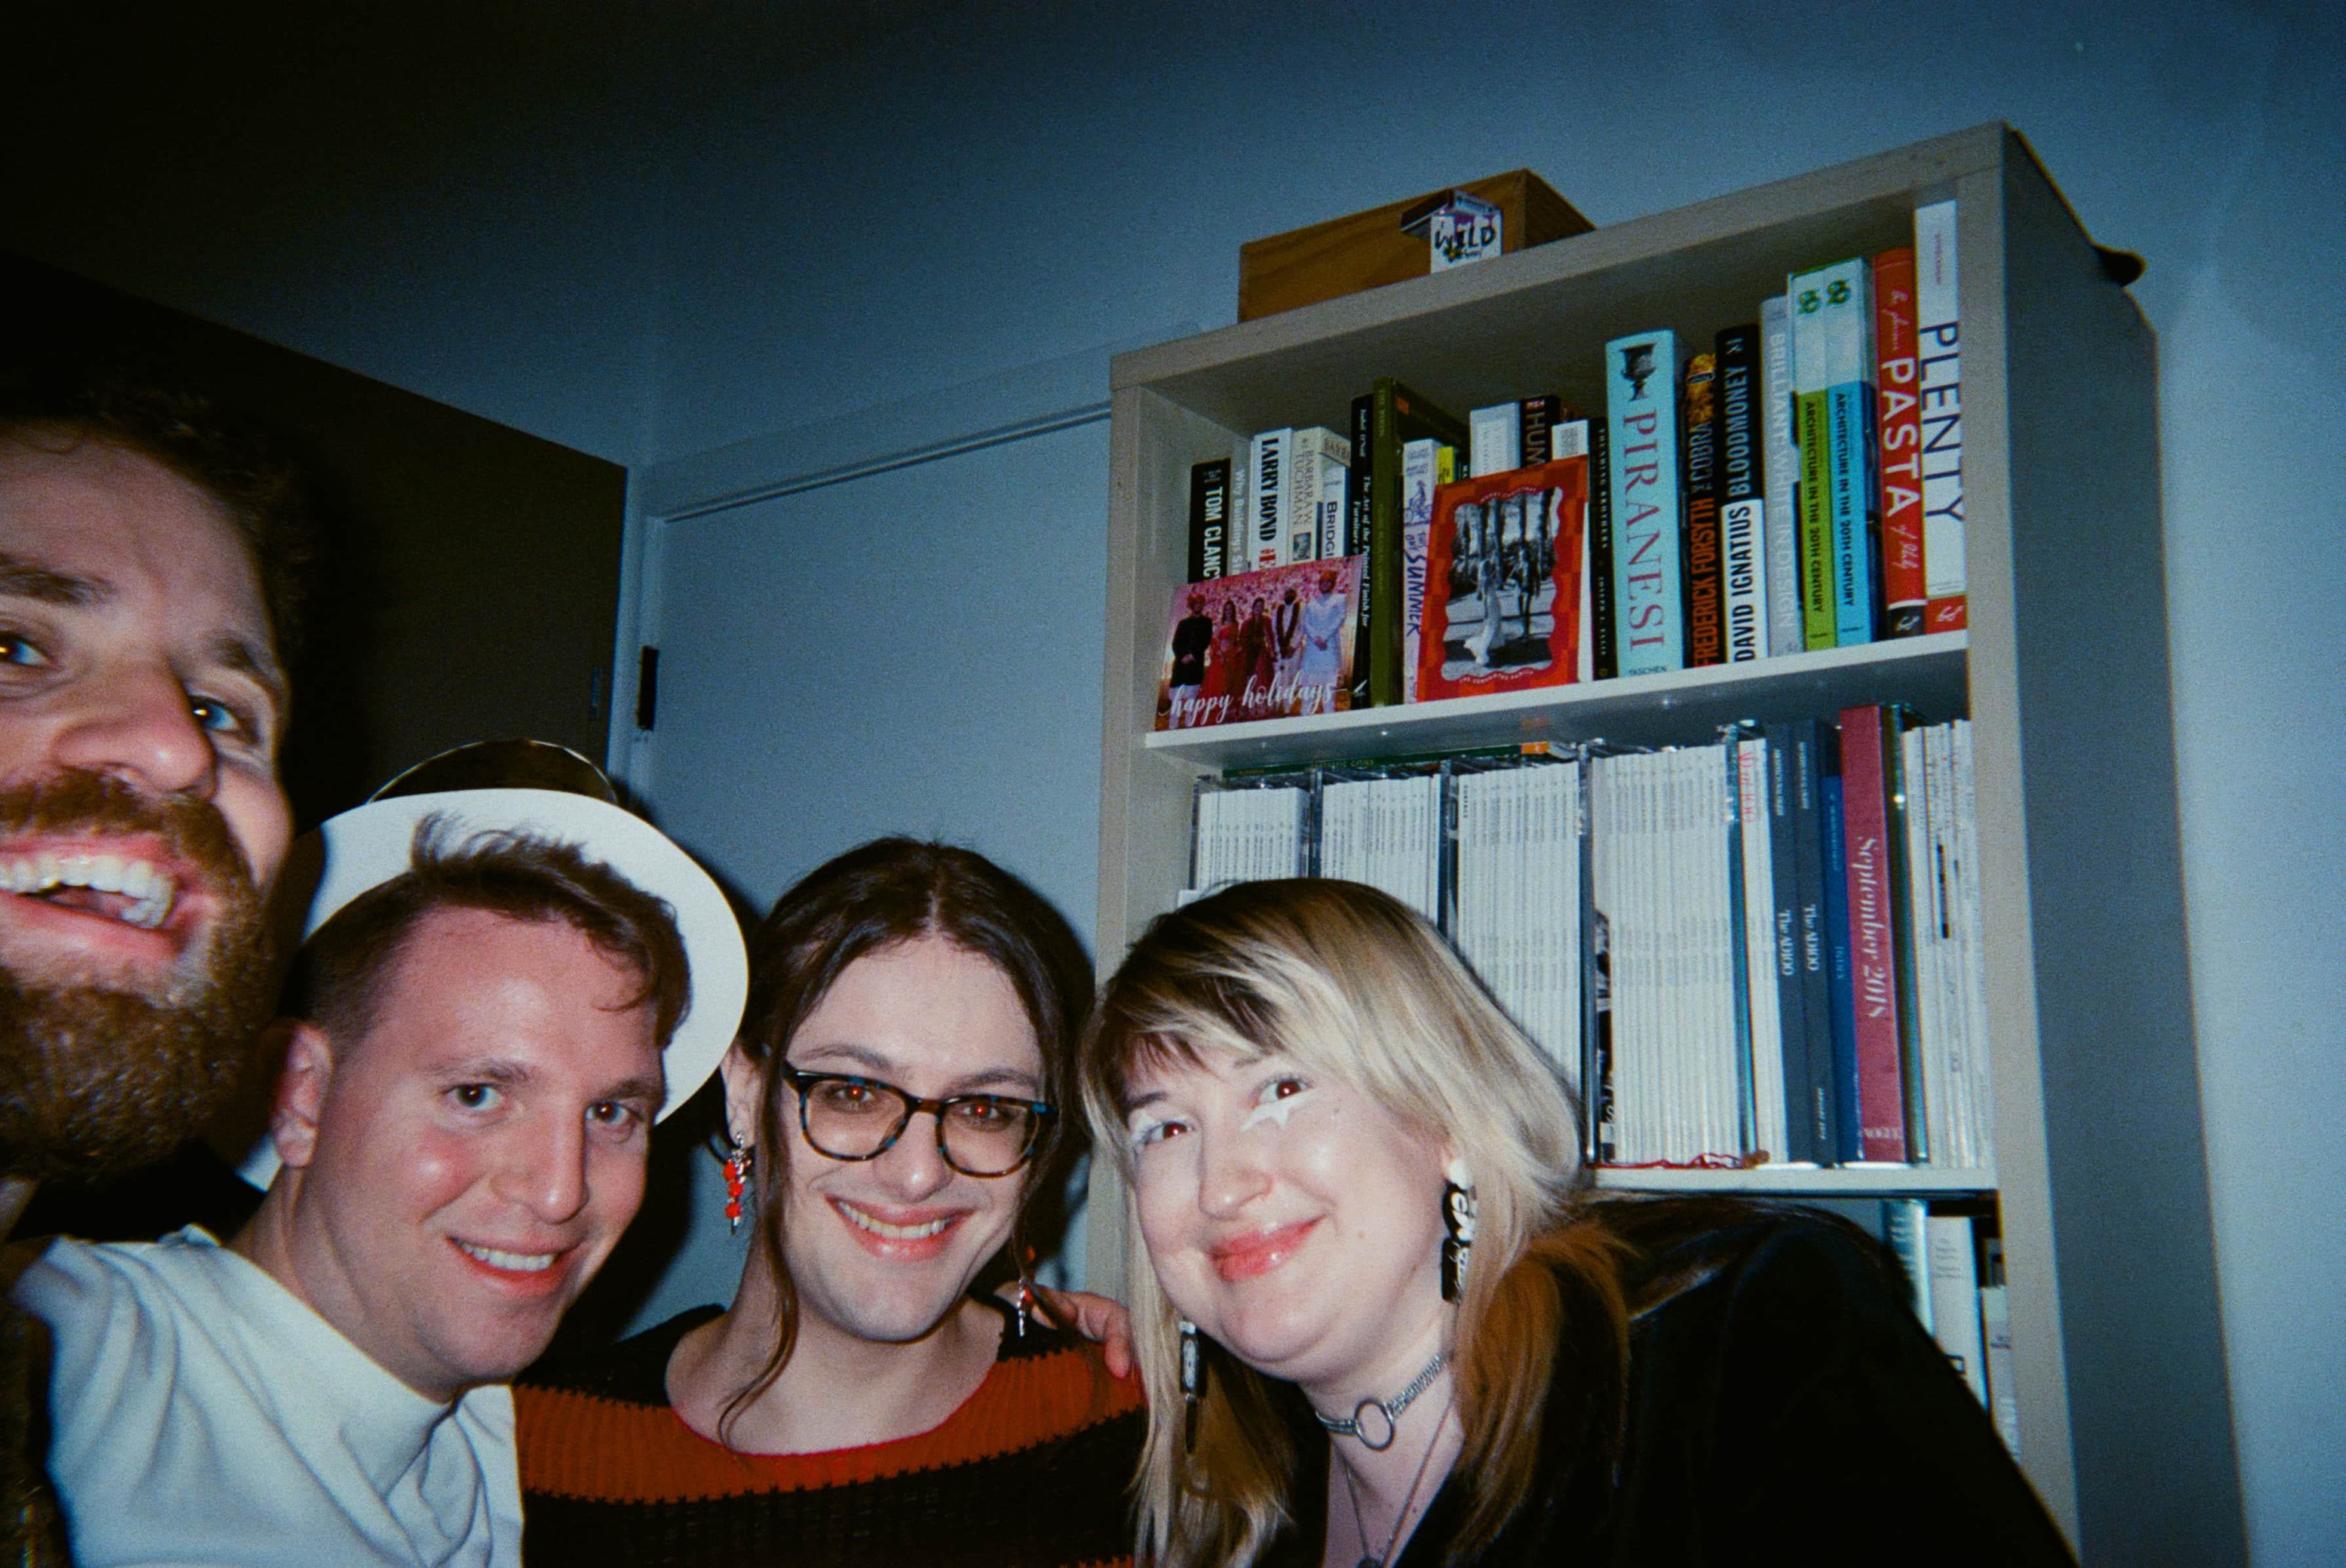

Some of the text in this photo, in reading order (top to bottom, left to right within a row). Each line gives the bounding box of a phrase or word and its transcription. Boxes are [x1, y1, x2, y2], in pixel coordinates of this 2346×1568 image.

[1723, 365, 1750, 497] BLOODMONEY
[1881, 357, 1920, 517] PASTA
[1920, 321, 1963, 522] PLENTY
[1261, 439, 1279, 491] LARRY
[1304, 450, 1314, 506] BARBARA
[1689, 421, 1714, 481] COBRA
[1205, 486, 1222, 520] TOM
[1234, 469, 1245, 495] Why
[1293, 453, 1304, 524] TUCHMAN
[1772, 450, 1790, 519] WHITE
[1805, 401, 1823, 613] ARCHITECTURE IN THE 20TH CENTURY
[1836, 393, 1854, 607] ARCHITECTURE IN THE 20TH CENTURY
[1232, 499, 1243, 552] Buildings
[1260, 496, 1277, 541] BOND
[1353, 501, 1361, 544] Furniture
[1362, 514, 1370, 525] of
[1362, 528, 1370, 542] the
[1623, 410, 1666, 650] PIRANESI
[1774, 521, 1791, 544] IN
[1361, 583, 1370, 611] Finish
[1689, 498, 1719, 666] FREDERICK FORSYTH
[1727, 505, 1756, 661] DAVID IGNATIUS
[1775, 550, 1793, 629] DESIGN
[1361, 613, 1370, 627] for
[1167, 670, 1347, 726] happy holidays
[1778, 910, 1792, 935] The
[1803, 904, 1817, 929] The
[1851, 836, 1888, 1018] September 2018
